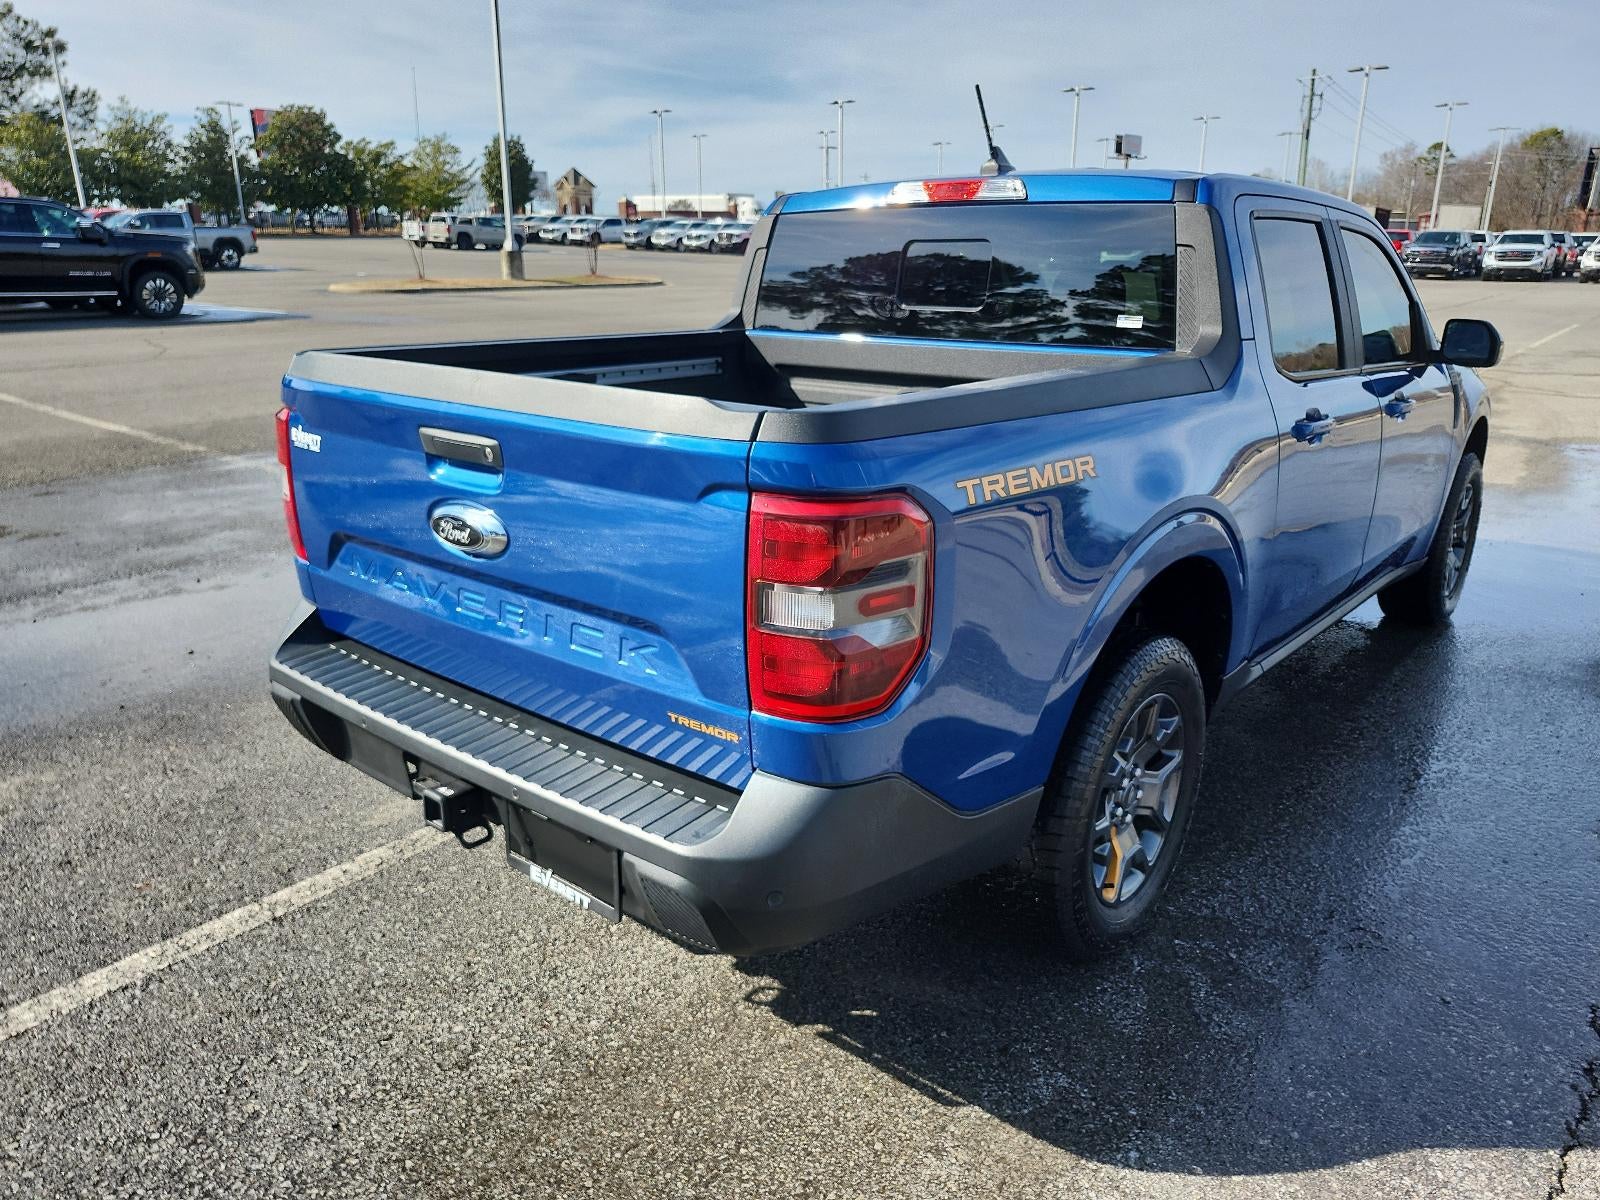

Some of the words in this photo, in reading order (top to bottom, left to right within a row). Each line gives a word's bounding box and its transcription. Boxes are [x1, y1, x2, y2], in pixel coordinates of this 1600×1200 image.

[955, 455, 1097, 505] TREMOR
[439, 517, 471, 545] Ford
[349, 553, 660, 676] MAVERICK
[666, 710, 741, 744] TREMOR
